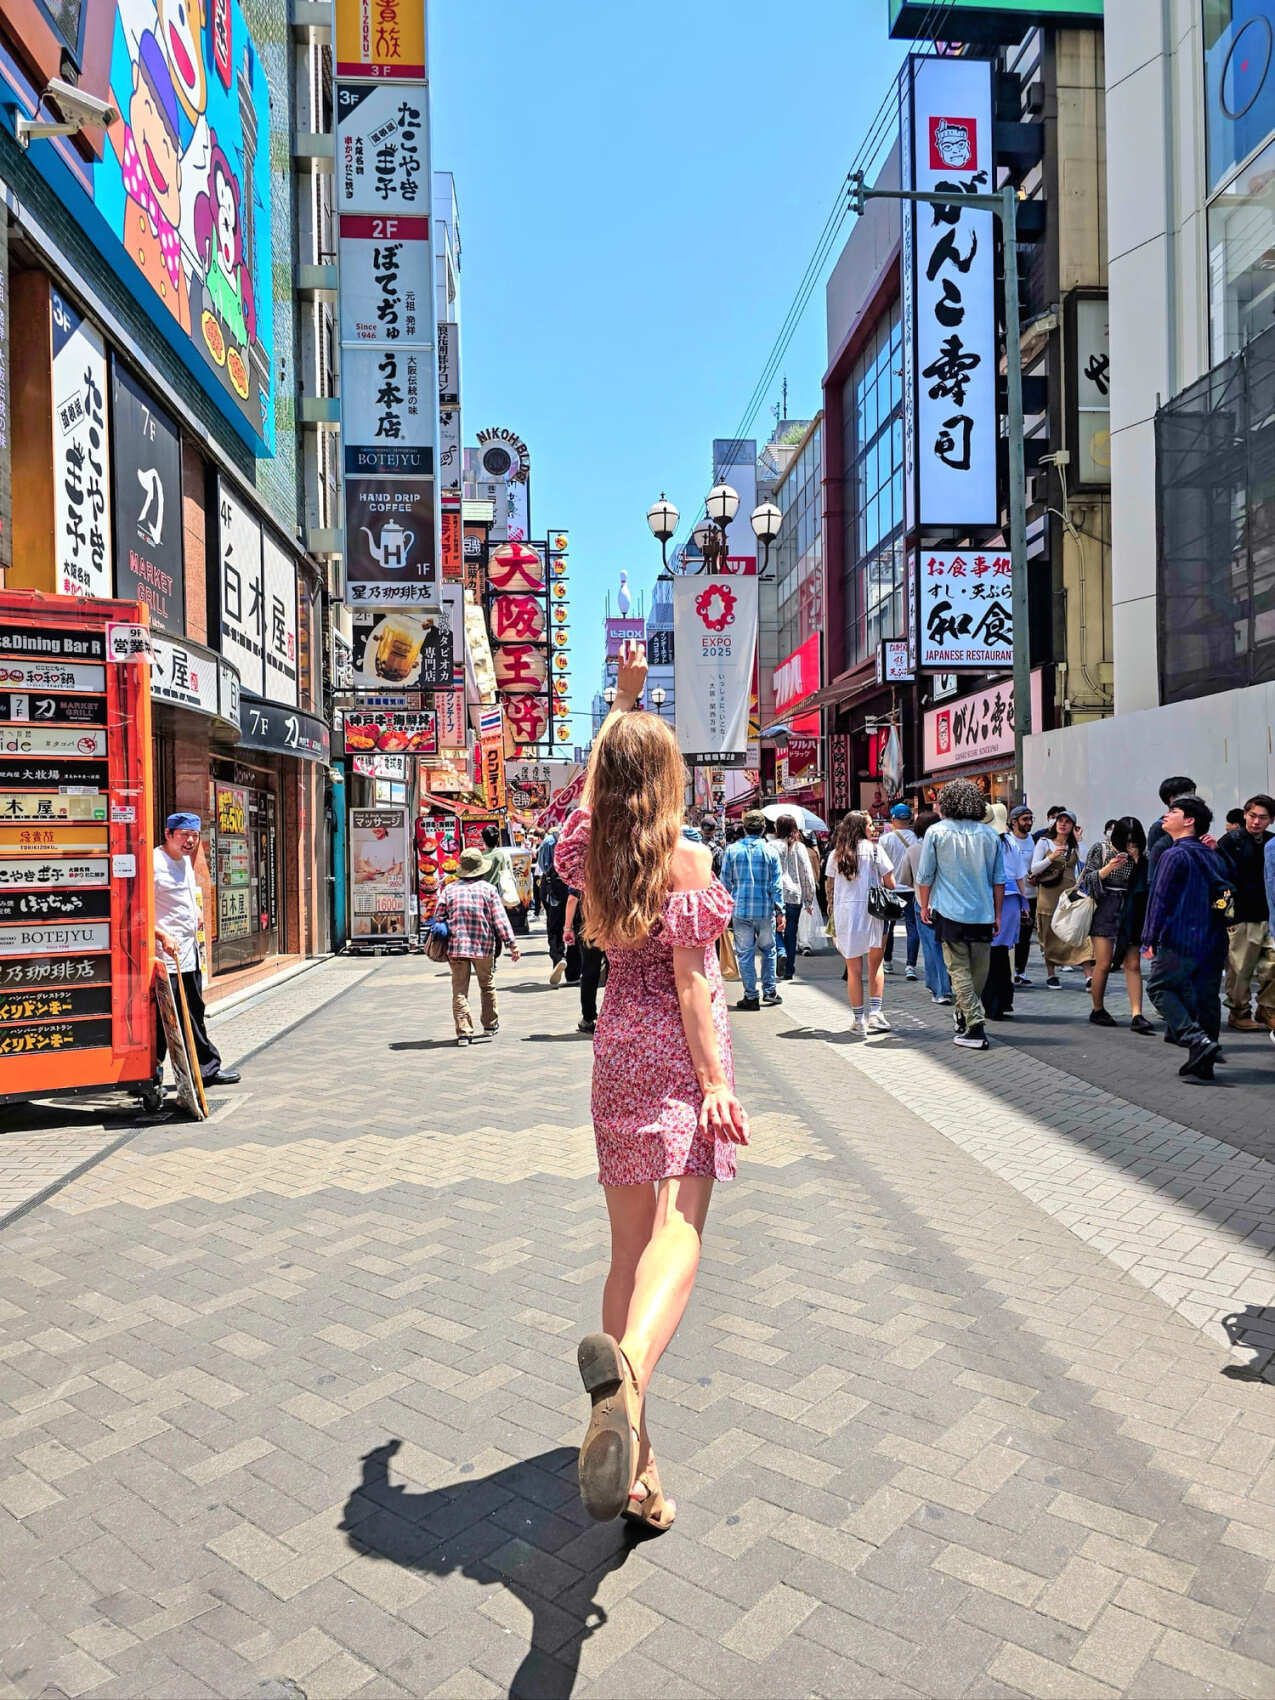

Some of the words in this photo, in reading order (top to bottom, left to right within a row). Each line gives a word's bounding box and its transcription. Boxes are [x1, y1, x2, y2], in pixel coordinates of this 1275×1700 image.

[339, 90, 359, 105] 3F
[397, 101, 422, 202] たこやき
[372, 220, 399, 238] 2F
[53, 296, 71, 333] 3F
[356, 322, 377, 331] Since
[357, 331, 377, 339] 1946
[140, 404, 157, 441] 7F
[358, 453, 421, 467] BOTEJYU
[83, 365, 105, 573] たこやき
[360, 493, 391, 501] HAND
[395, 493, 421, 502] DRIP
[369, 503, 413, 512] COFFEE
[220, 500, 233, 530] 4F
[63, 557, 91, 588] 大阪名物
[128, 549, 174, 597] MARKET
[416, 563, 431, 576] 1F
[224, 543, 288, 656] 白木屋
[352, 585, 432, 601] 星乃珈琲店
[137, 582, 169, 619] GRILL
[926, 600, 1014, 647] 和食
[63, 638, 88, 654] Bar
[92, 640, 101, 654] R
[702, 638, 731, 647] EXPO
[702, 648, 731, 657] 2025
[925, 650, 964, 661] JAPANESE
[425, 646, 437, 682] 専門店
[60, 701, 100, 710] MARKET
[65, 709, 94, 717] GRILL
[249, 709, 269, 735] 7F
[789, 740, 817, 750] ツルハ
[22, 769, 60, 780] 大牧場
[354, 817, 401, 827] マッサージ
[8, 992, 71, 1001] ハンバーグレストラン
[10, 1024, 73, 1034] ハンバーグレストラン
